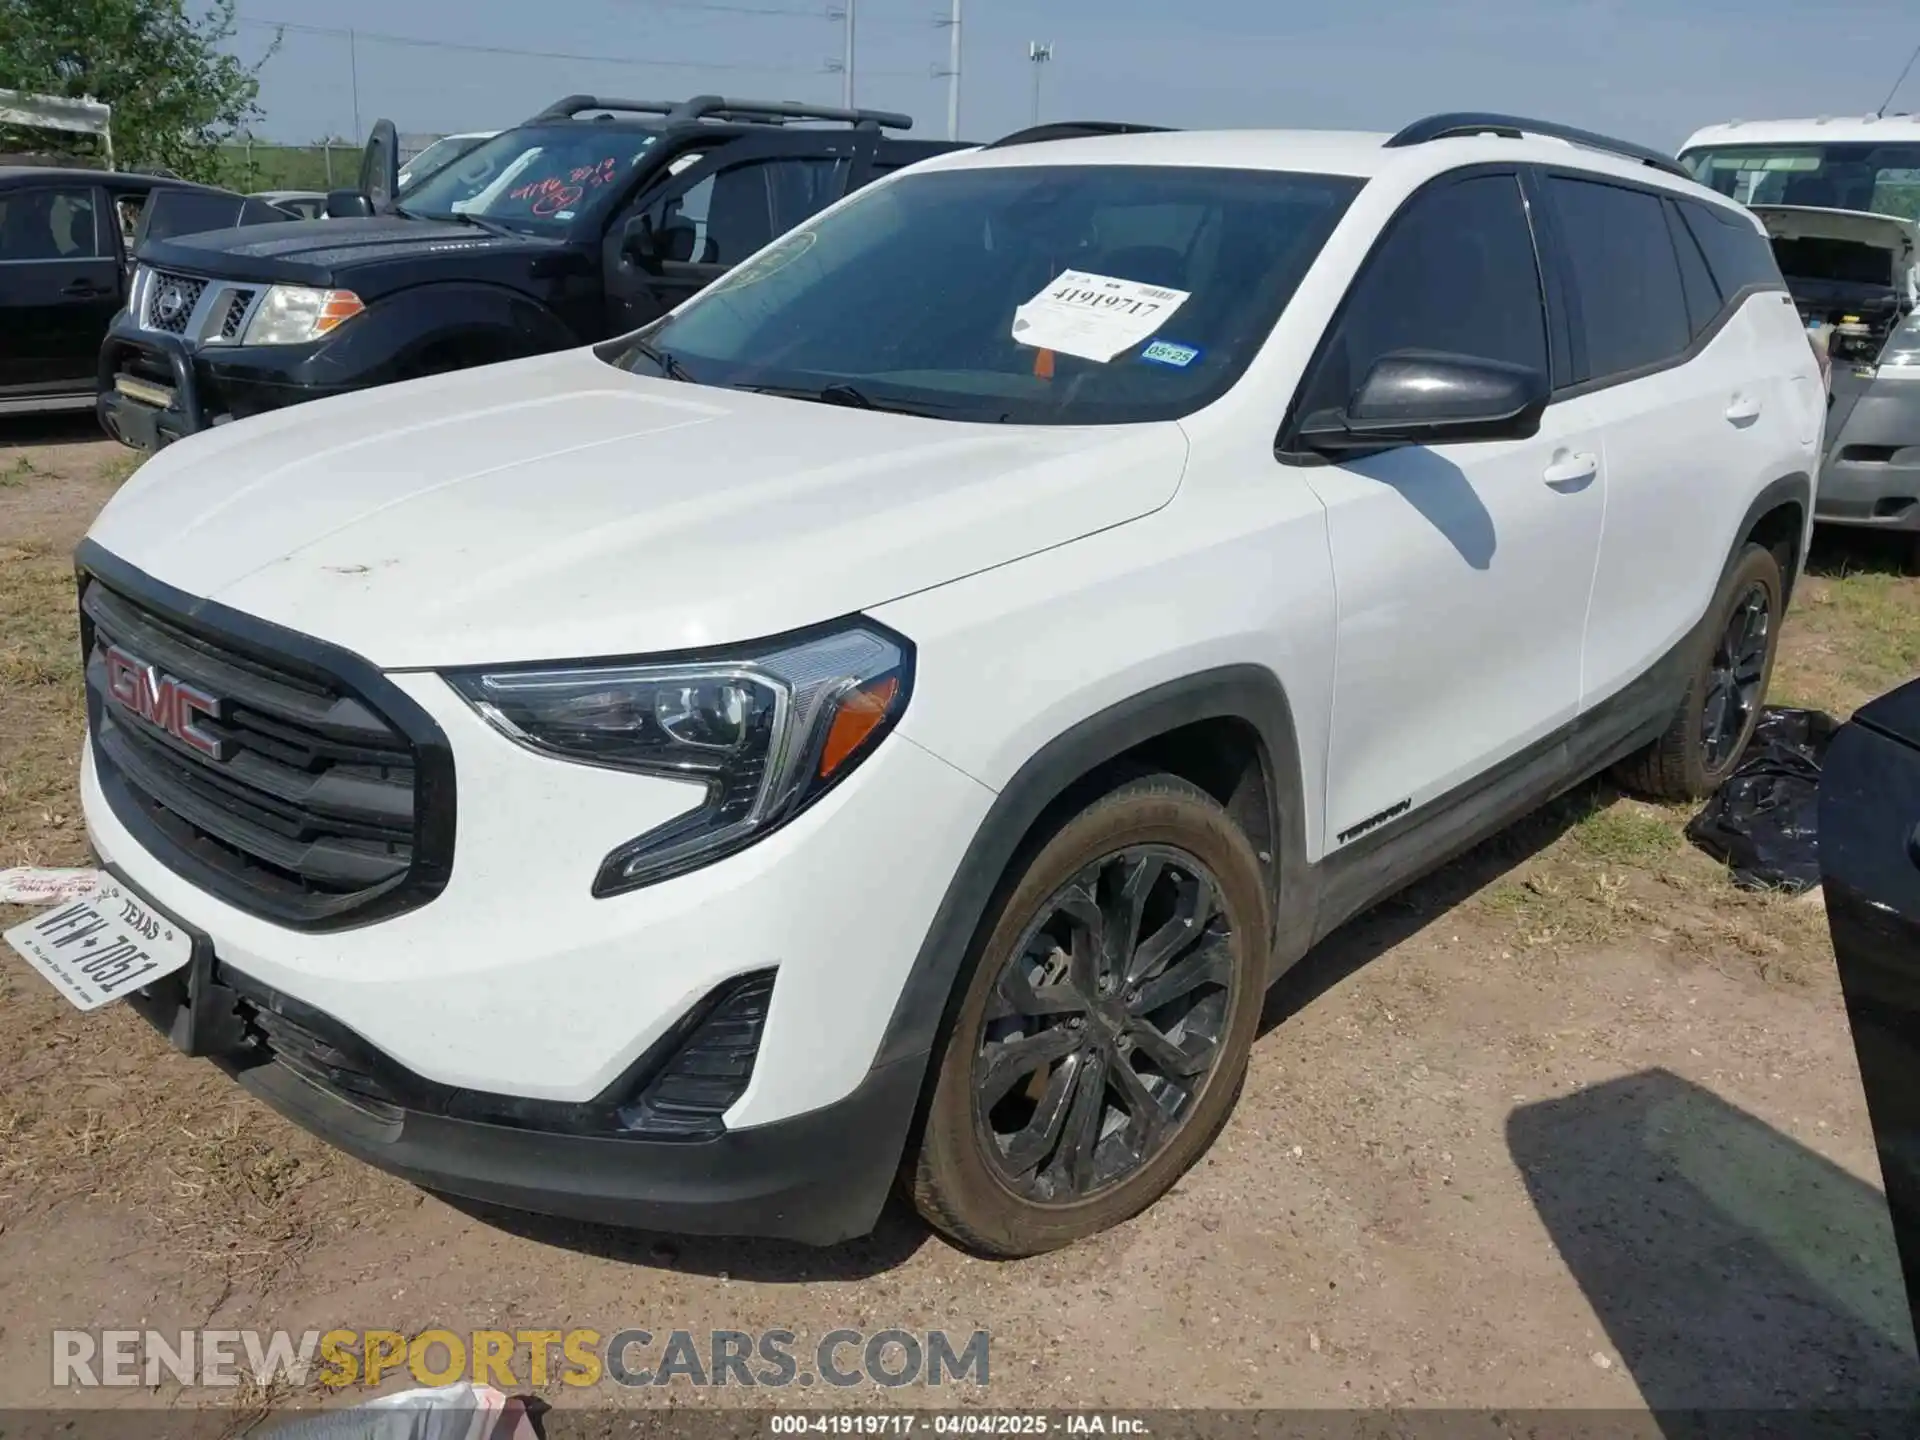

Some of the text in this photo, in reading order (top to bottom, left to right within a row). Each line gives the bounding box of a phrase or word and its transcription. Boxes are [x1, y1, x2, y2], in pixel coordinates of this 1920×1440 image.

[1052, 287, 1161, 317] 41919717
[107, 644, 222, 761] GMC
[118, 898, 161, 941] TEXAS
[71, 934, 158, 993] 7051
